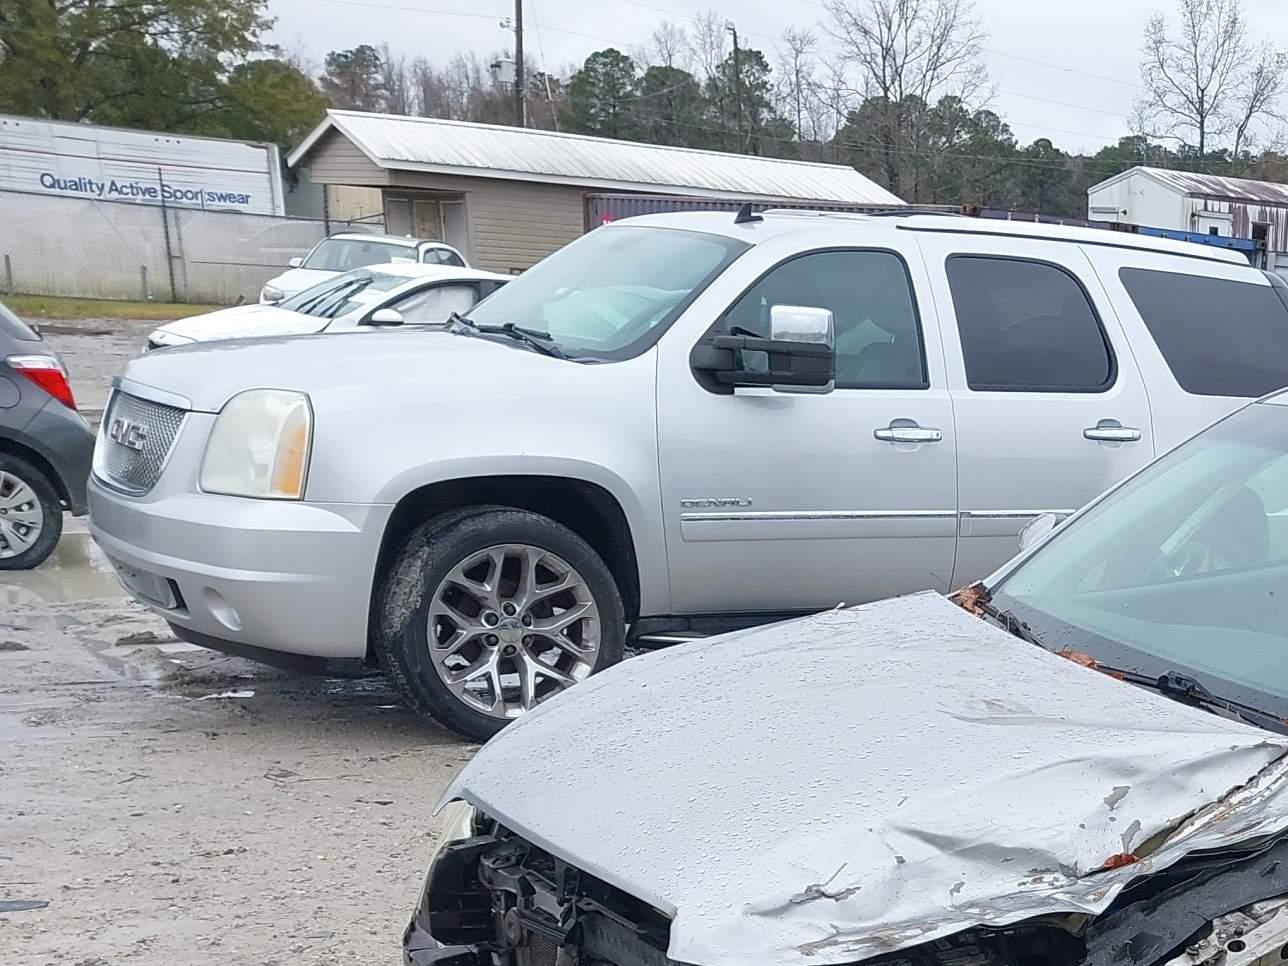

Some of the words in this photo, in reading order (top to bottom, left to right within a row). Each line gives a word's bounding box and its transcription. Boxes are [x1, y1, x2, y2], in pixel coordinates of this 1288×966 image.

[40, 172, 105, 197] Quality
[108, 179, 158, 199] Active
[110, 417, 149, 452] GMC
[680, 497, 753, 508] DENALI
